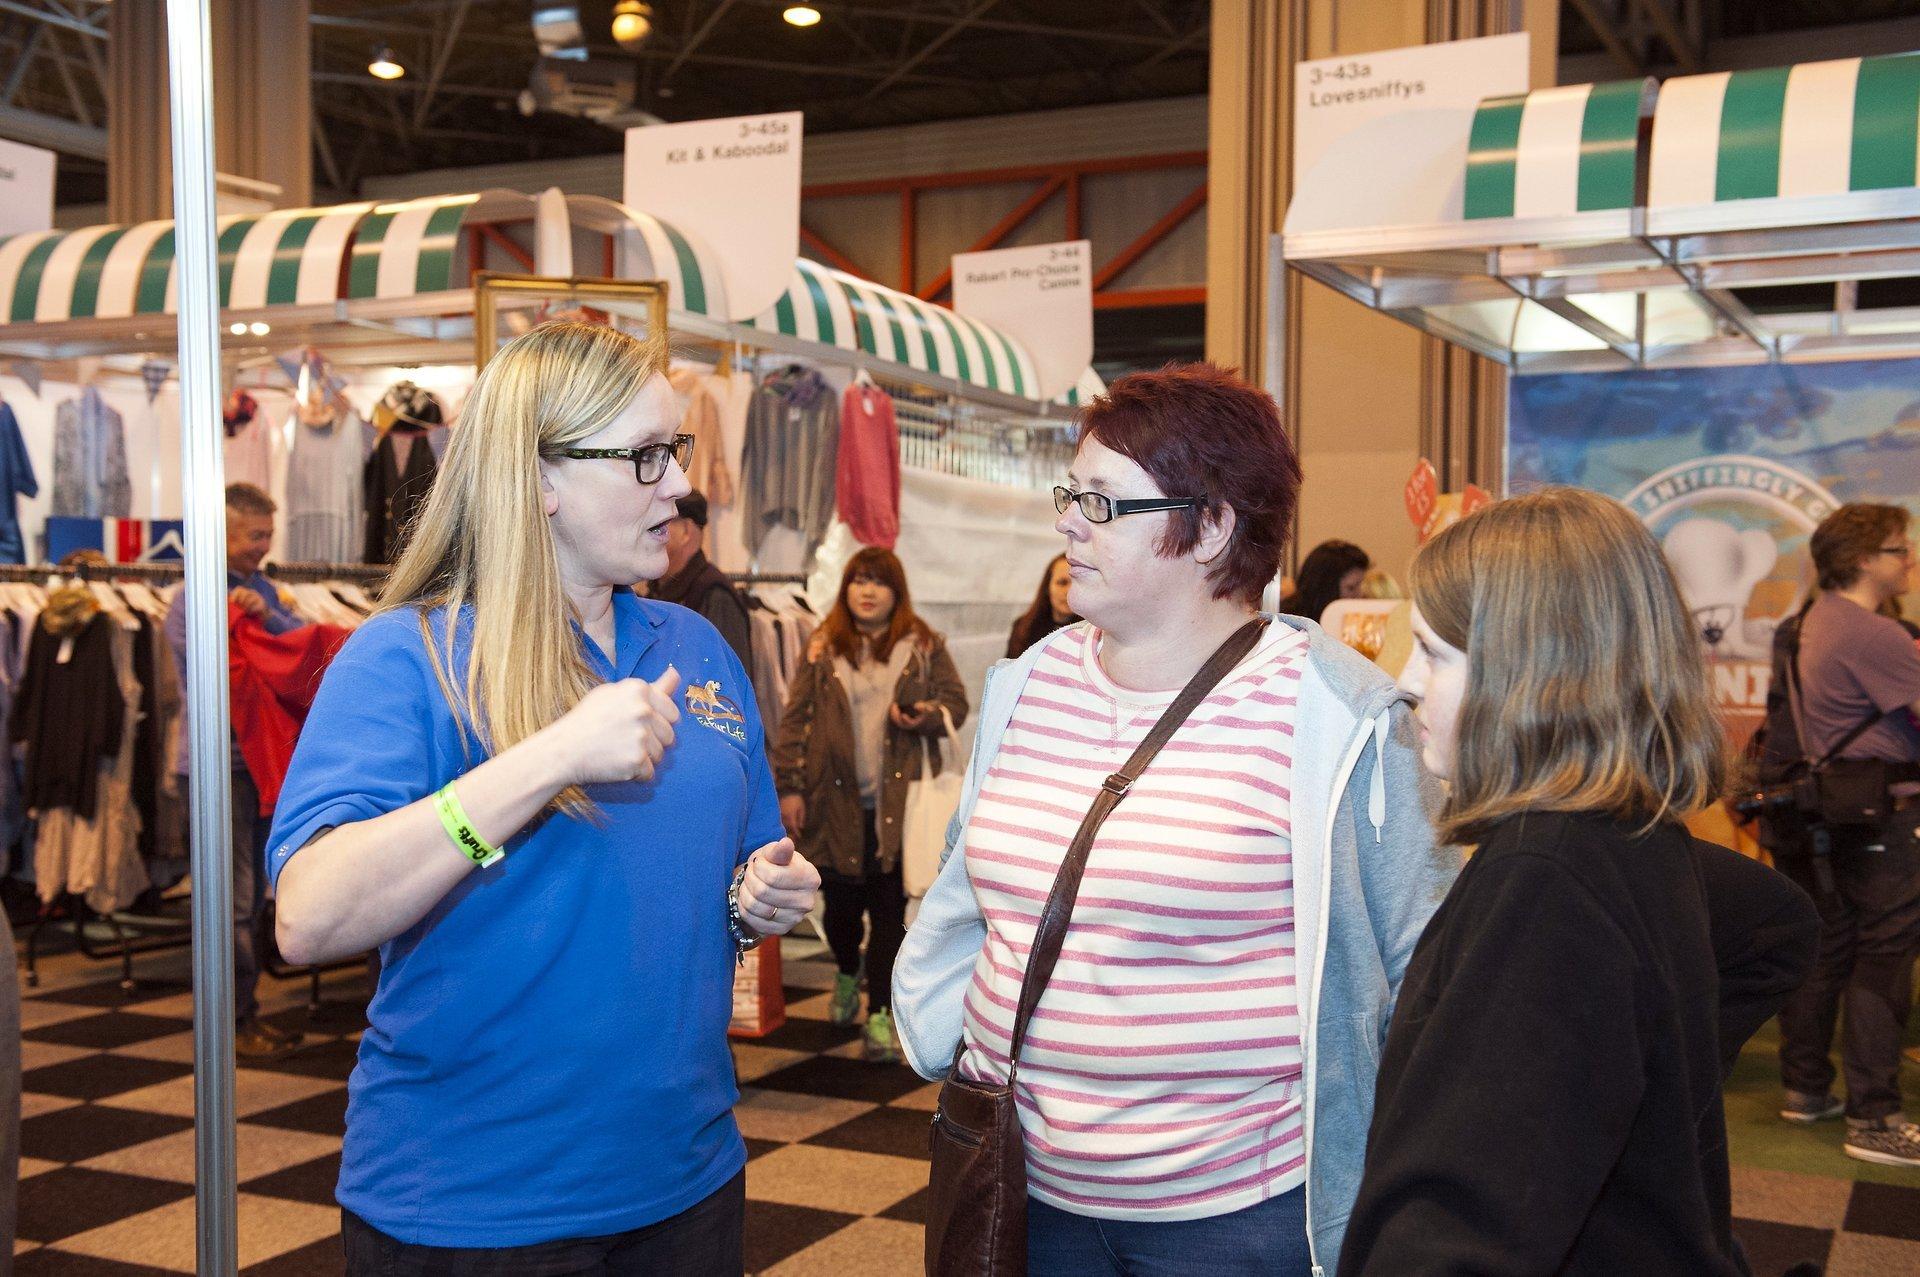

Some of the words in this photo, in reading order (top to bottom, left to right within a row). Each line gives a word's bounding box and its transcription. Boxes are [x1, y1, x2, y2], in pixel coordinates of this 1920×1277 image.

[1310, 62, 1371, 85] 3-43a
[1310, 80, 1425, 107] Lovesniffys
[739, 120, 789, 138] 3-45a
[666, 147, 688, 163] Kit
[695, 145, 705, 161] &
[713, 140, 789, 159] Kaboodal
[1039, 278, 1080, 291] Canine
[1643, 466, 1803, 508] SNIFFINGLY
[459, 825, 488, 860] Crufts
